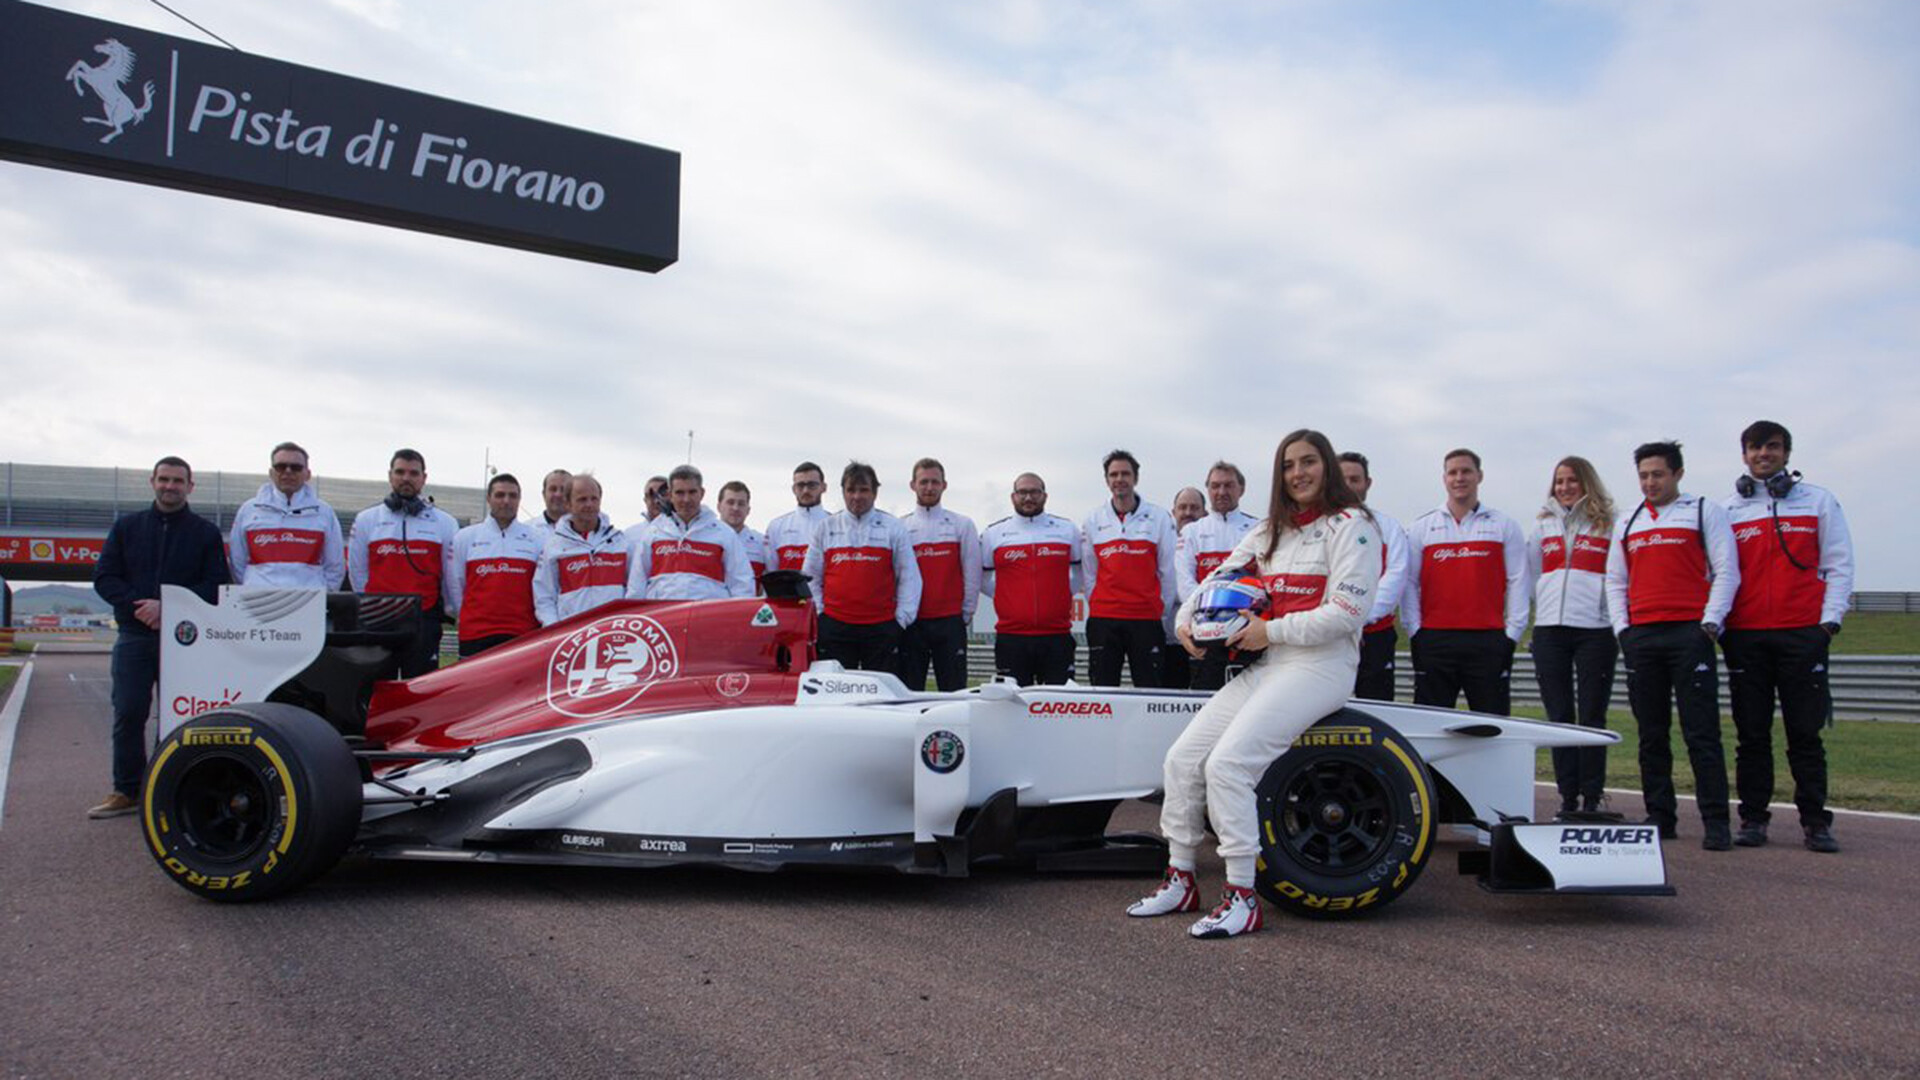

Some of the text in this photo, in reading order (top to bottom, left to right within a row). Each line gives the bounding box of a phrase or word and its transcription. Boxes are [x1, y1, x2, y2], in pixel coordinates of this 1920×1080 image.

[190, 85, 605, 211] Pista di Fiorano
[59, 547, 102, 560] V-Po
[1269, 578, 1318, 595] Romeo
[205, 628, 247, 640] Sauber
[268, 629, 302, 641] Team
[556, 619, 672, 675] ALFA ROMEO
[825, 680, 878, 694] Silanna
[1029, 702, 1112, 715] CARRERA
[1147, 702, 1206, 713] RICHAR
[182, 726, 252, 746] PIRELLI
[1560, 828, 1654, 844] POWER
[165, 857, 252, 889] ZERO
[1274, 880, 1380, 911] ZERO
